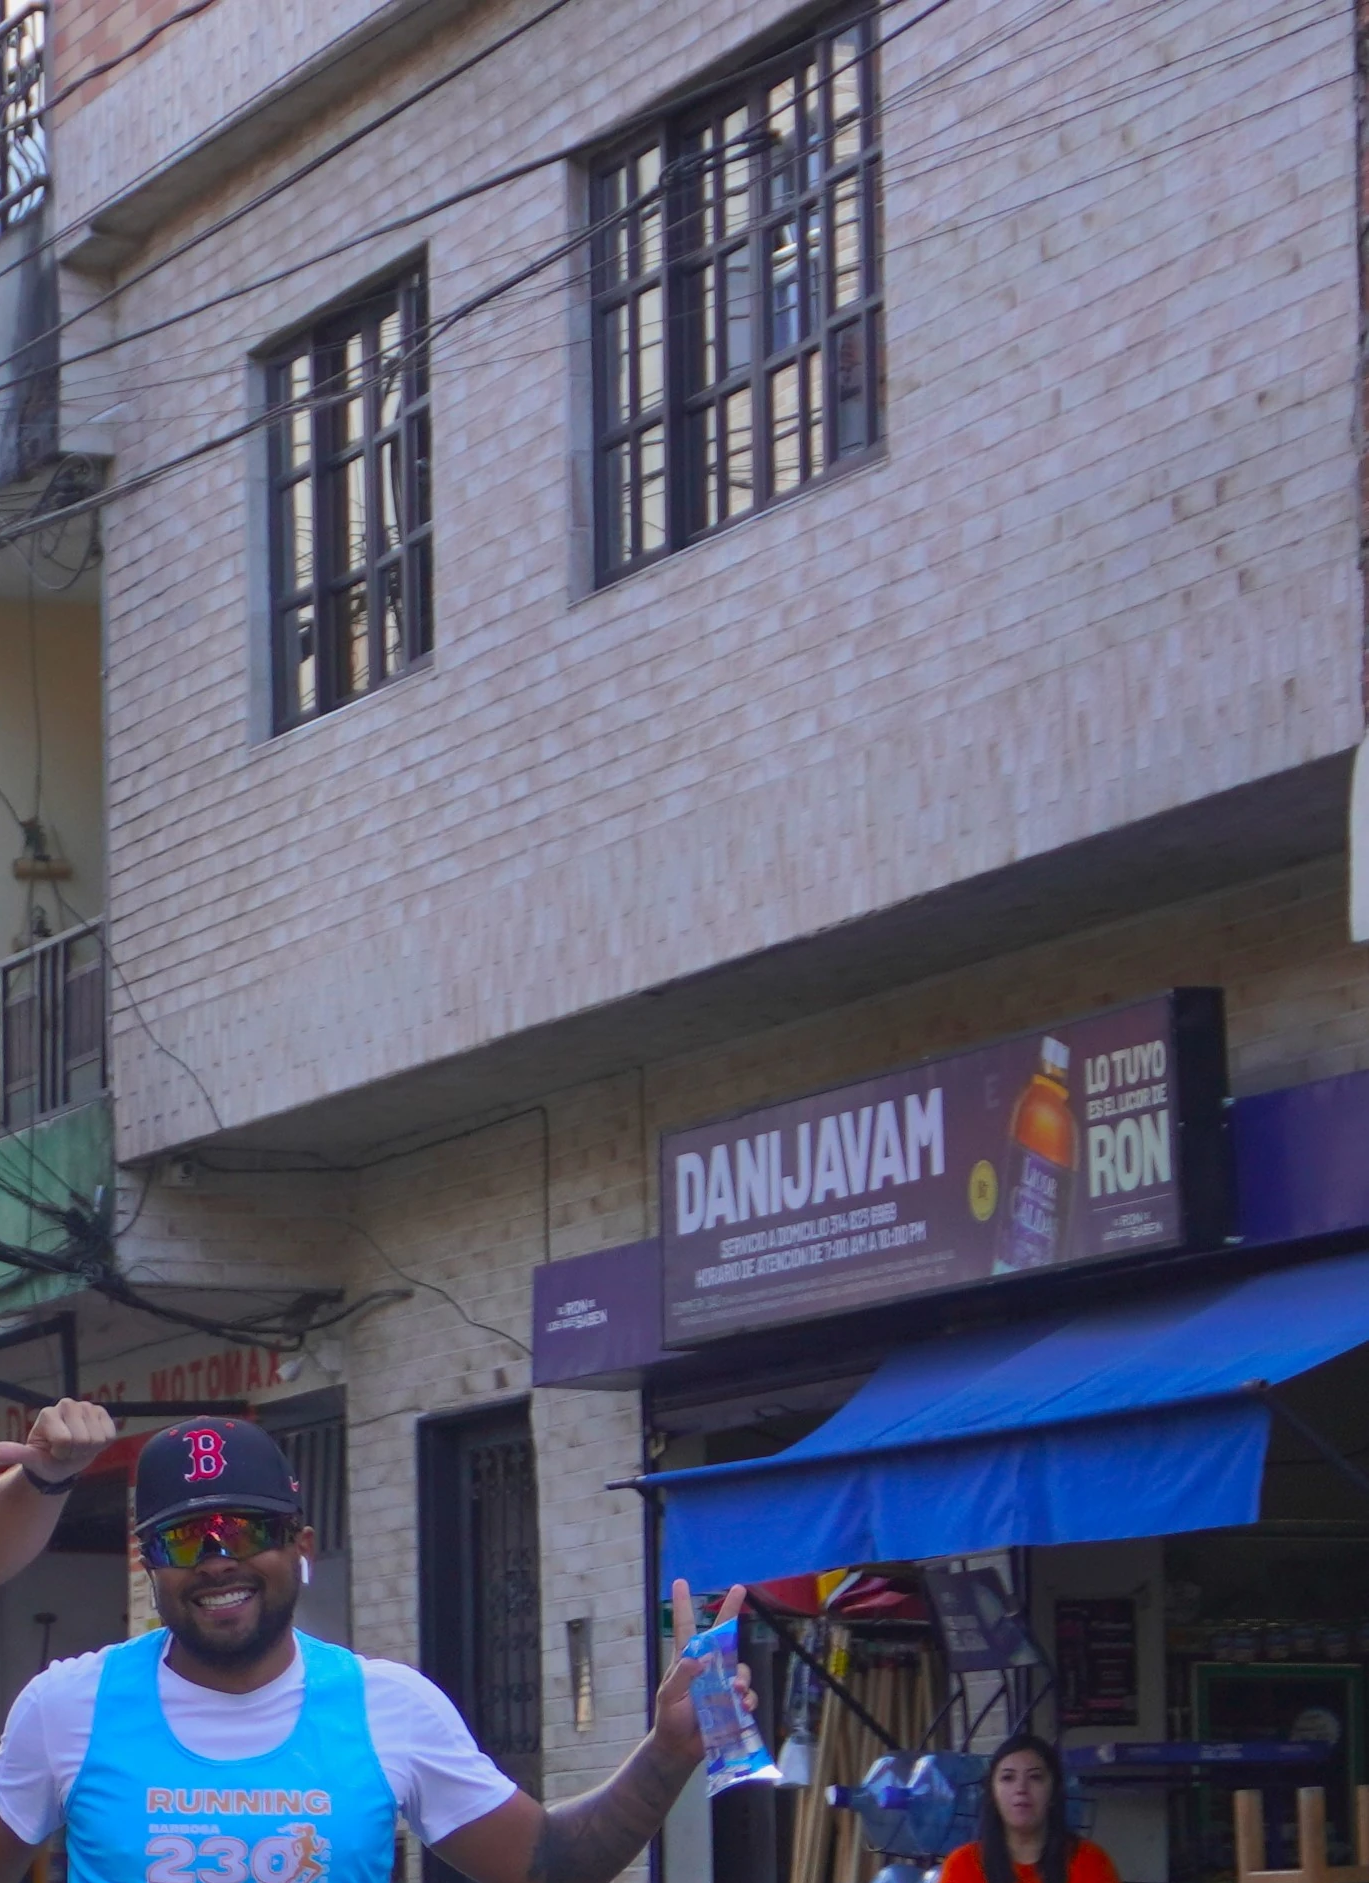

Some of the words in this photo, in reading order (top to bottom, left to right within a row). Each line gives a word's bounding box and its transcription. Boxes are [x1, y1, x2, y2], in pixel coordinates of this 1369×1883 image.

[1084, 1054, 1110, 1095] LO
[1112, 1040, 1166, 1087] TUYO
[1086, 1099, 1103, 1121] ES
[1104, 1095, 1118, 1117] EL
[1117, 1086, 1151, 1113] LICOR
[1151, 1082, 1168, 1105] DE
[676, 1087, 946, 1236] DANIJAVAM
[1089, 1109, 1171, 1198] RON
[695, 1262, 739, 1289] HORARIO
[741, 1258, 755, 1279] DE
[810, 1243, 824, 1264] DE
[850, 1233, 867, 1255] AM
[910, 1220, 927, 1242] PM
[720, 1231, 767, 1259] SERVICIO
[777, 1217, 829, 1246] DOMICILIO
[565, 1299, 588, 1315] RON
[151, 1341, 285, 1400] MOTOMAX
[183, 1429, 226, 1483] B
[147, 1788, 332, 1815] RUNNING
